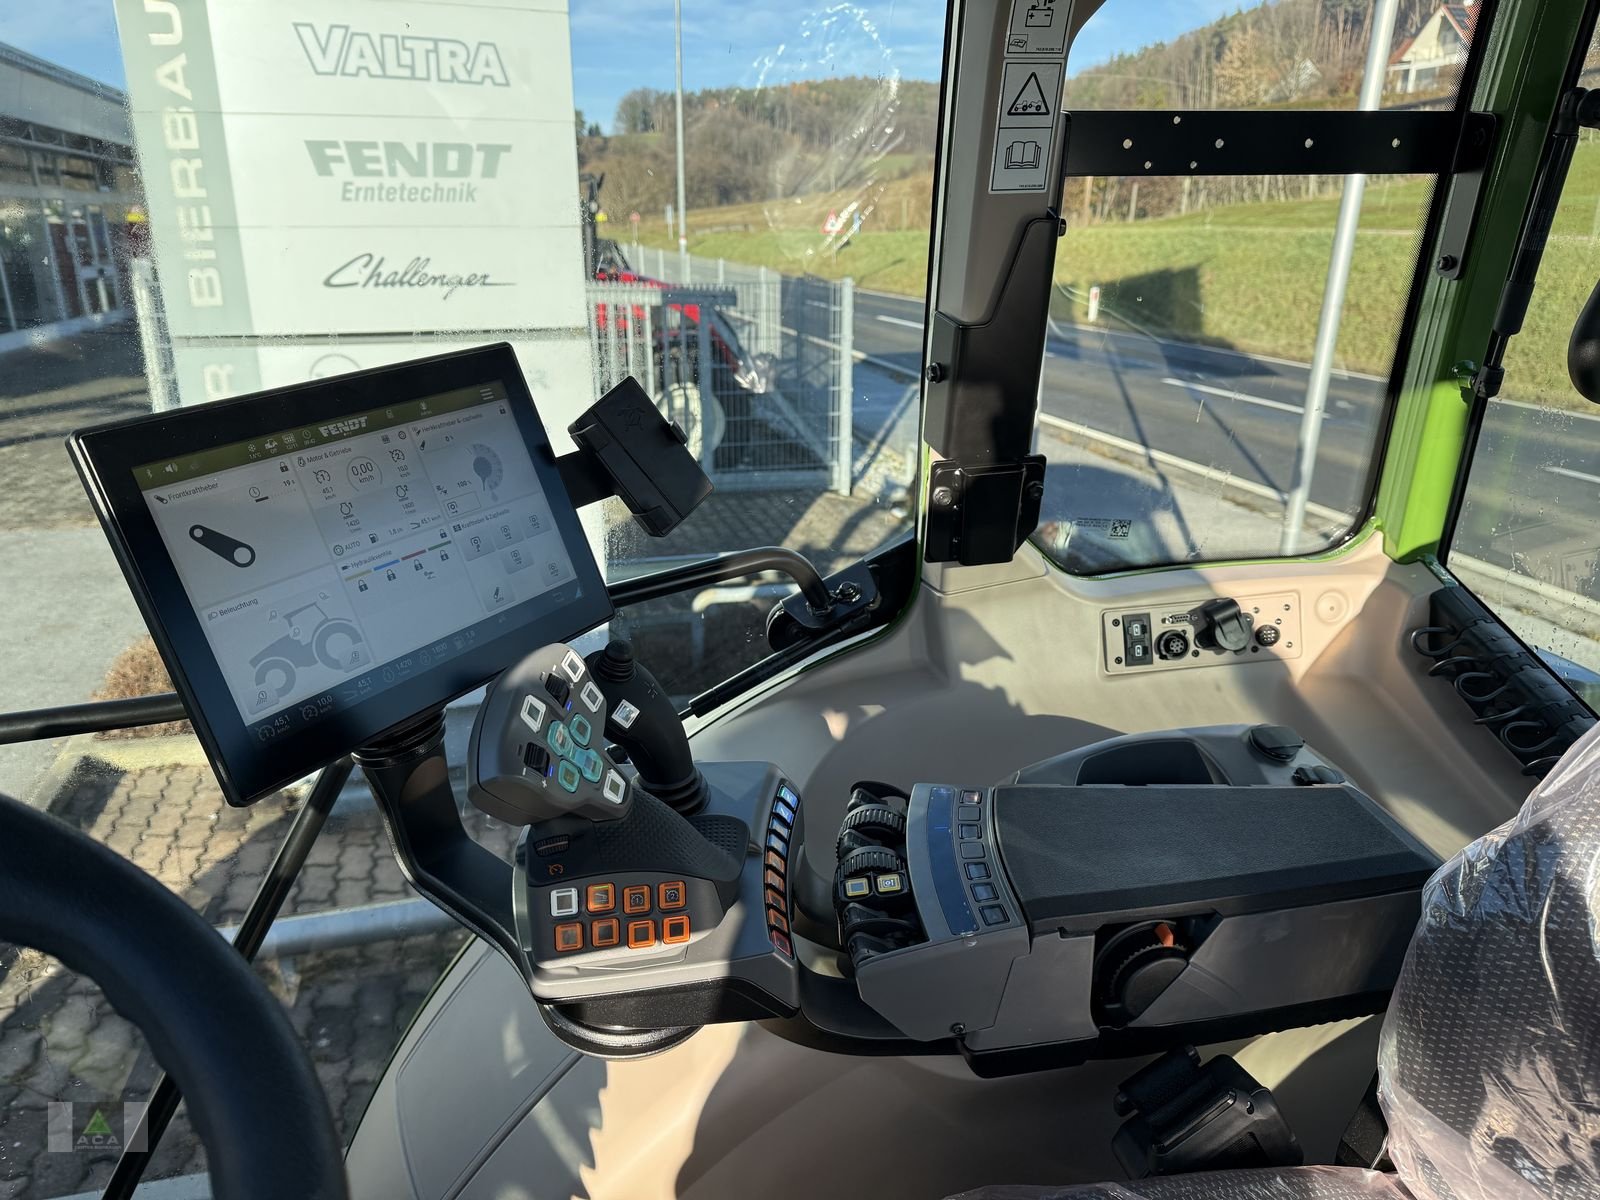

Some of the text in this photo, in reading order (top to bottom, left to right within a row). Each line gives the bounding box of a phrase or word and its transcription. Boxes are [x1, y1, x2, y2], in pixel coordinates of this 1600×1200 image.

[293, 22, 511, 88] VALTRA
[304, 139, 512, 180] FENDT
[341, 181, 477, 203] Erntetechnik
[323, 253, 517, 299] Challenger
[319, 416, 368, 436] FENDT
[306, 454, 324, 463] Motor
[328, 446, 351, 457] Getriebe
[350, 461, 374, 476] 0,00
[358, 474, 375, 484] km/h
[168, 482, 218, 500] Frontkraftheber
[321, 486, 334, 494] 45,1
[344, 540, 361, 550] AUTO
[219, 597, 258, 616] Beleuchtung
[274, 715, 291, 727] 45,1
[317, 695, 334, 707] 10,0
